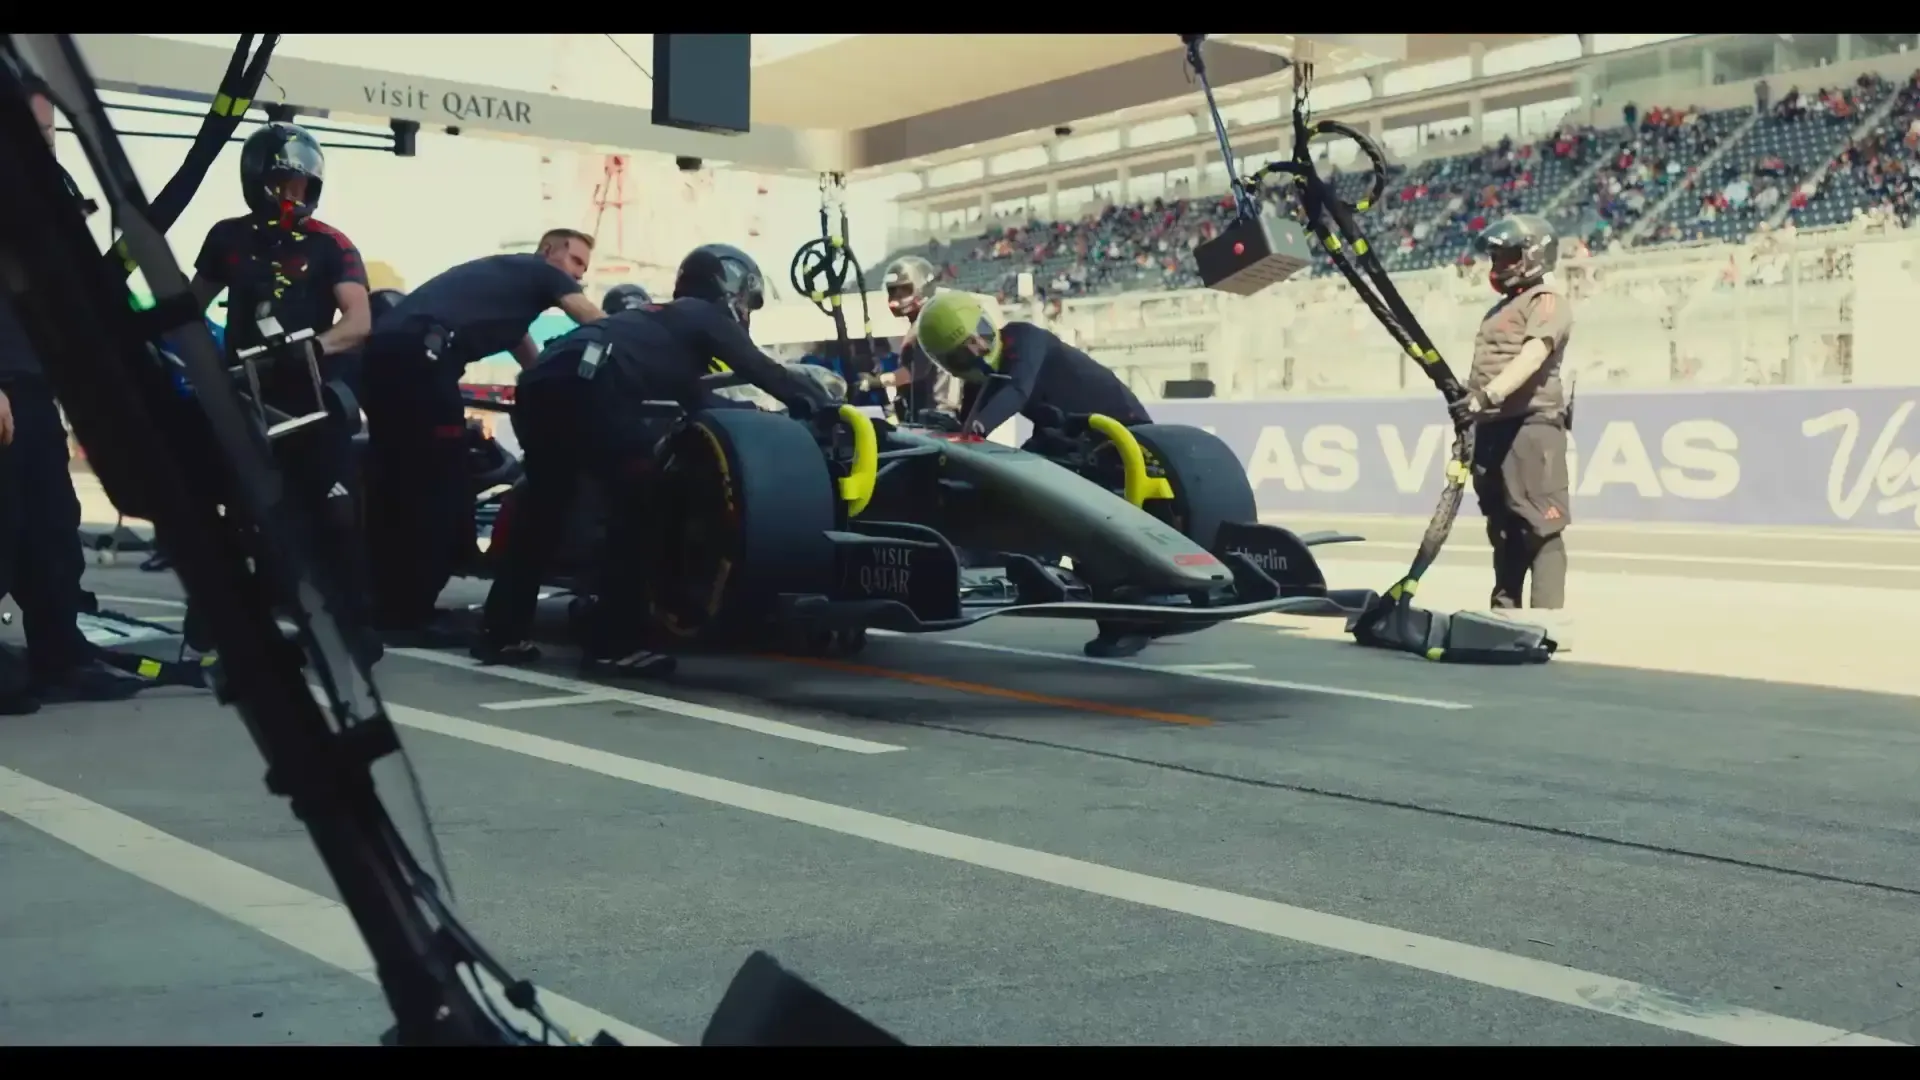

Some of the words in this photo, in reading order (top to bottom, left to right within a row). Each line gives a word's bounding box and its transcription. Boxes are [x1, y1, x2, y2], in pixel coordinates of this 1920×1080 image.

[363, 81, 430, 110] visit
[442, 92, 532, 125] QATAR
[1203, 424, 1360, 492] AS
[1376, 418, 1740, 499] VAS
[873, 547, 912, 566] VISIT
[860, 565, 910, 596] QATAR
